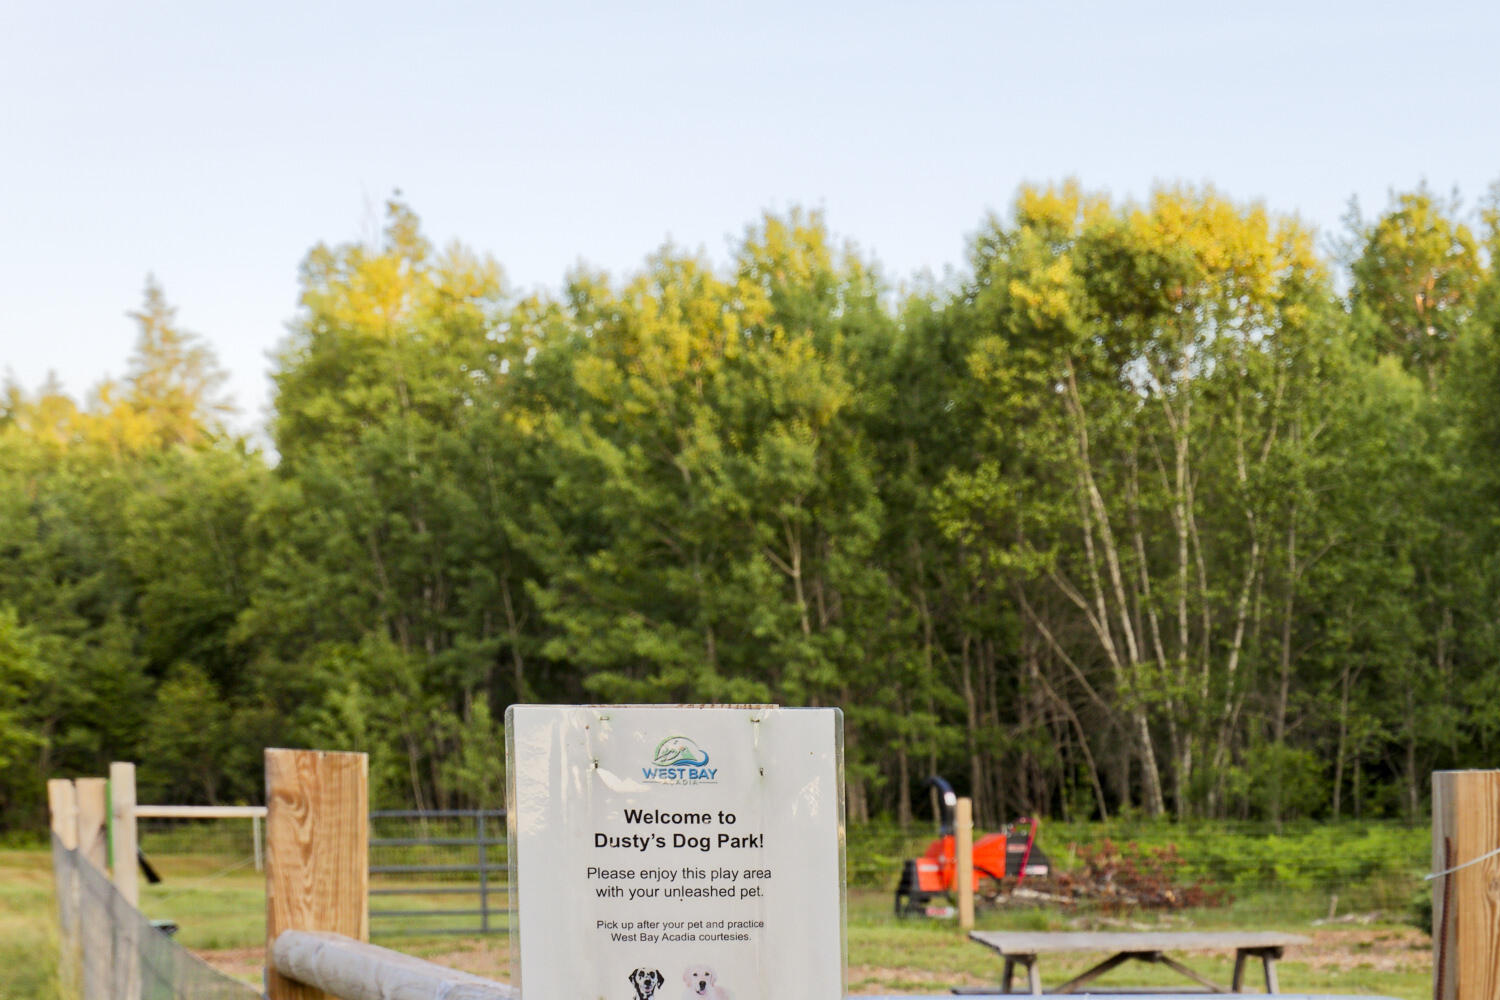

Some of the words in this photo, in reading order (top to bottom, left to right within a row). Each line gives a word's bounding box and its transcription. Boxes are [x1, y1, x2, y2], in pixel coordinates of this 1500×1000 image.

[642, 767, 686, 780] WEST
[688, 767, 718, 780] BAY
[623, 809, 712, 825] Welcome
[718, 810, 737, 825] to
[594, 833, 666, 852] Dusty's
[673, 833, 711, 852] Dog
[717, 833, 764, 849] Park!
[587, 867, 636, 880] Please
[640, 867, 678, 883] enjoy
[682, 867, 707, 880] this
[711, 866, 740, 882] play
[743, 869, 772, 879] area
[596, 886, 624, 898] with
[629, 887, 660, 901] your
[664, 886, 736, 898] unleashed
[740, 886, 764, 900] pet.
[596, 920, 619, 930] Pick
[621, 922, 634, 931] up
[637, 920, 660, 929] after
[662, 921, 684, 931] your
[687, 920, 703, 930] pet
[706, 920, 725, 929] and
[727, 920, 764, 930] practice
[611, 933, 637, 943] West
[640, 933, 659, 944] Bay
[662, 933, 696, 942] Acadia
[698, 932, 752, 942] courtesies.
